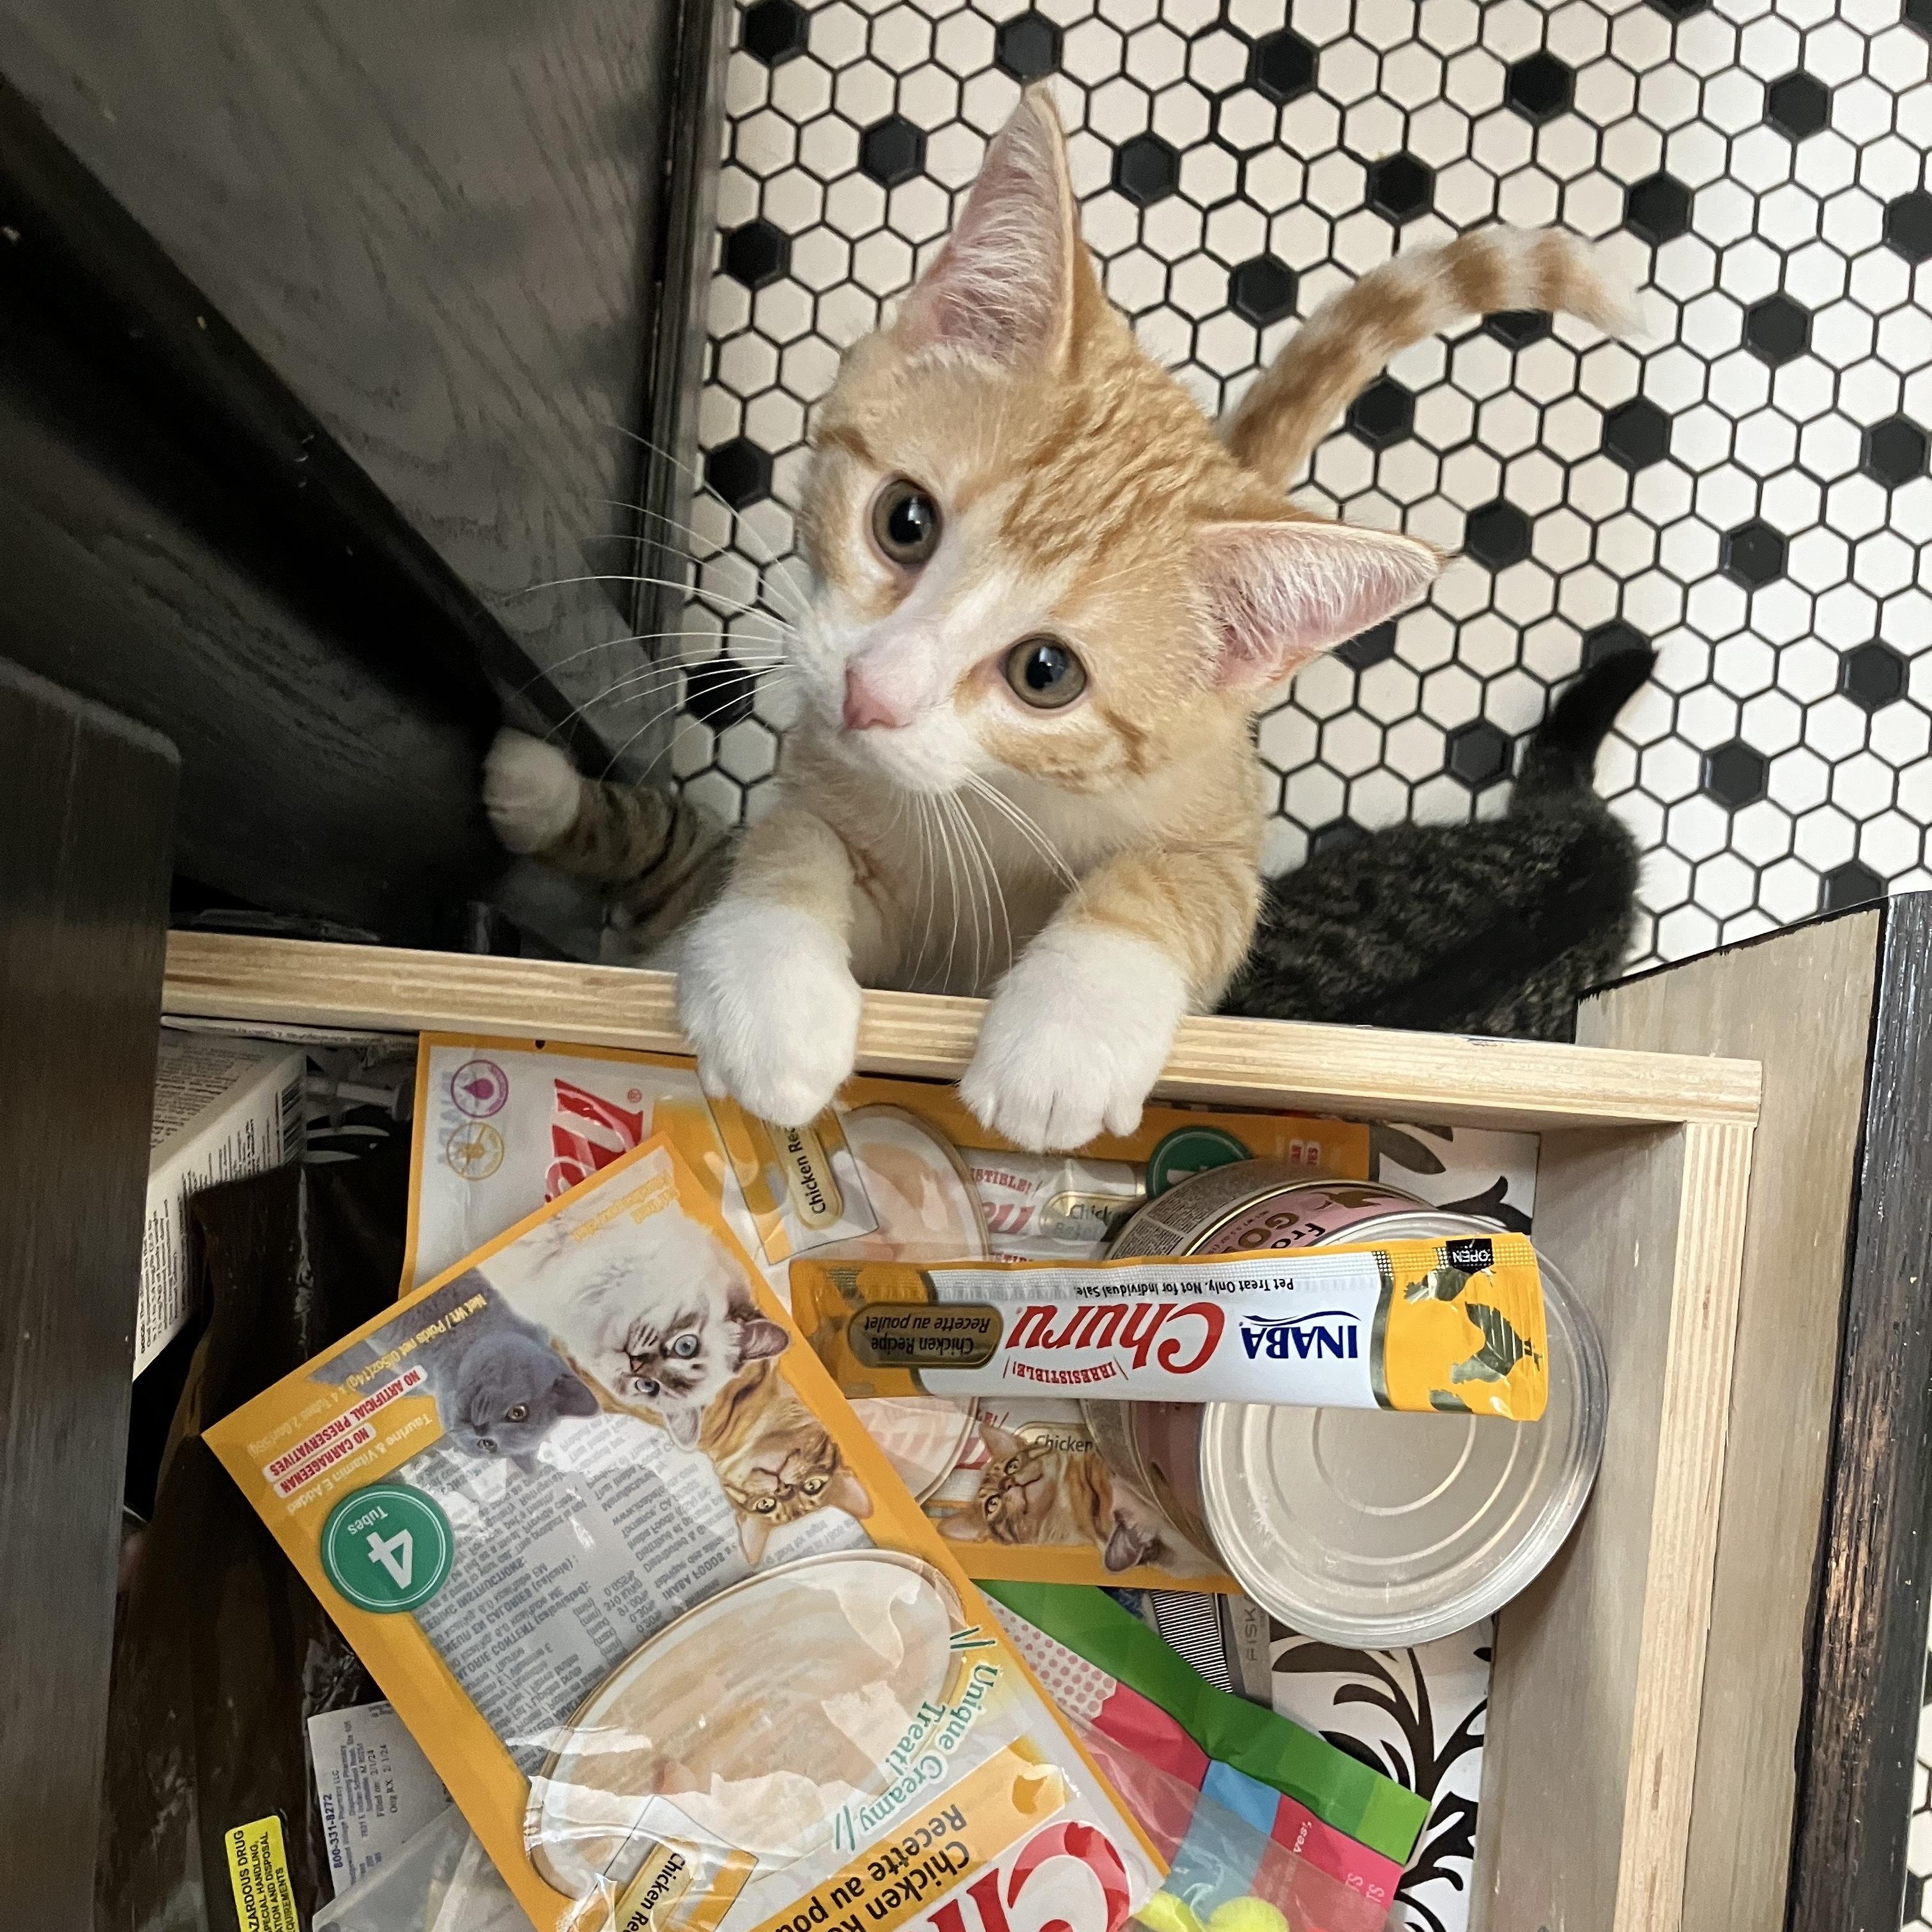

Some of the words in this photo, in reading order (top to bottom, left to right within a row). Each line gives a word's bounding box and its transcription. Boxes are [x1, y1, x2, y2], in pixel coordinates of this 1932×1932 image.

[792, 1154, 827, 1216] Chicken
[1452, 1250, 1488, 1262] OPEN
[1073, 1284, 1098, 1296] Sale.
[1102, 1280, 1158, 1298] Individual
[1162, 1282, 1178, 1295] for
[1180, 1281, 1201, 1295] Not
[1204, 1278, 1235, 1295] Only.
[1238, 1278, 1269, 1292] Treat
[1273, 1277, 1293, 1290] Pet
[463, 1292, 487, 1314] Net
[415, 1319, 447, 1346] Poids
[864, 1312, 910, 1334] poulet
[913, 1317, 930, 1330] au
[933, 1316, 990, 1333] Recette
[1004, 1296, 1225, 1375] Churu
[397, 1337, 418, 1357] net
[871, 1332, 914, 1354] Recipe
[919, 1336, 973, 1356] Chicken
[1239, 1321, 1358, 1361] INABA
[402, 1369, 420, 1387] NO
[1013, 1359, 1116, 1385] IRRESISTIBLE!
[349, 1379, 406, 1422] ARTIFICIAL
[267, 1414, 353, 1476] PRESERVATIVES
[351, 1427, 370, 1445] NO
[384, 1411, 433, 1448] Taurine
[374, 1441, 388, 1455] &
[277, 1438, 355, 1494] CARRAGEENAN
[330, 1448, 377, 1484] Vitamin
[284, 1483, 325, 1515] Added
[345, 1504, 388, 1538] Tubes
[358, 1516, 433, 1595] 4
[937, 1664, 996, 1752] Unique
[885, 1702, 947, 1775] Treat!
[859, 1754, 941, 1832] Creamy
[322, 1793, 343, 1868] 800-331-8272
[866, 1803, 967, 1883] Recette
[233, 1830, 249, 1866] DRUG
[257, 1831, 275, 1880] DISPOSAL
[248, 1841, 267, 1894] HANDLING,
[640, 1852, 686, 1910] Chicken
[864, 1841, 968, 1922] Chicken
[266, 1882, 278, 1903] AND
[829, 1876, 865, 1909] au
